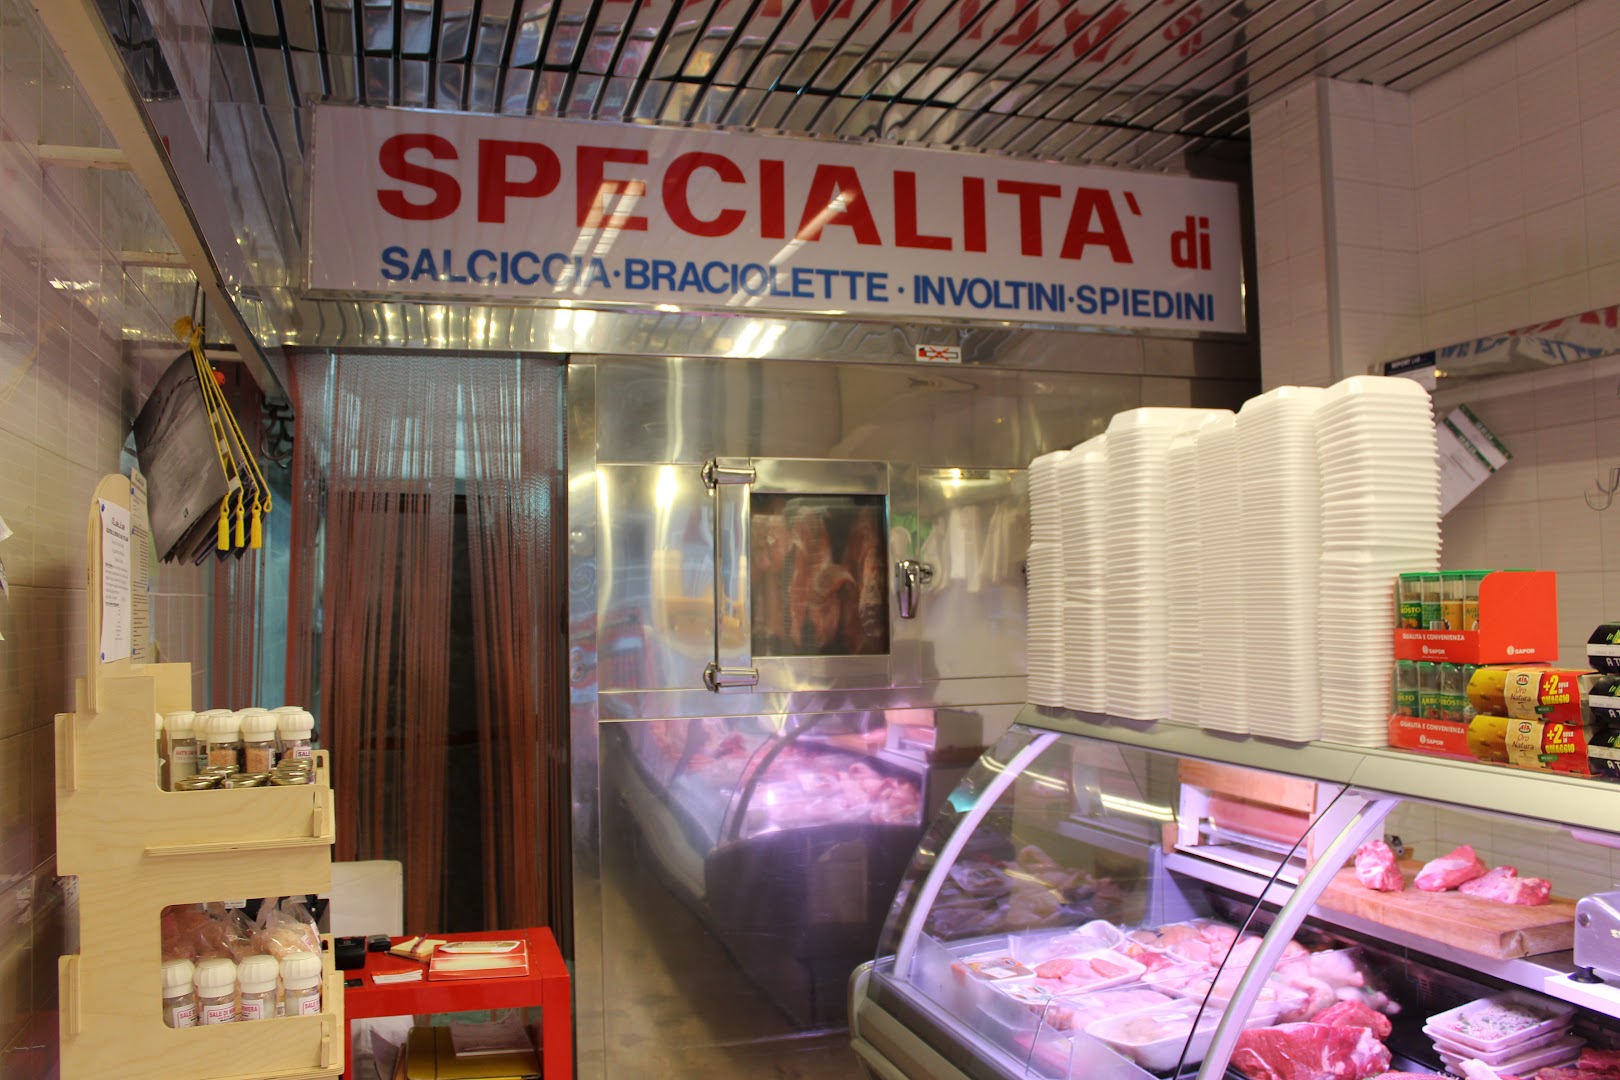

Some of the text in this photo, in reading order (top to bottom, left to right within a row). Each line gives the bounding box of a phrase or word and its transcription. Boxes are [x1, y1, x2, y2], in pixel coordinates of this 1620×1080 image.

[1170, 217, 1212, 270] di
[624, 258, 888, 302] BRACIOLETTE
[913, 275, 1066, 313] INVOLTINI
[1076, 284, 1215, 321] SPIEDINI
[1543, 674, 1559, 695] +2
[1510, 693, 1531, 702] Natura
[1541, 694, 1570, 705] OMAGGIO
[1517, 733, 1529, 741] Oro
[1547, 723, 1564, 744] +2
[1511, 741, 1534, 750] Natura
[1545, 743, 1575, 753] OMAGGIO
